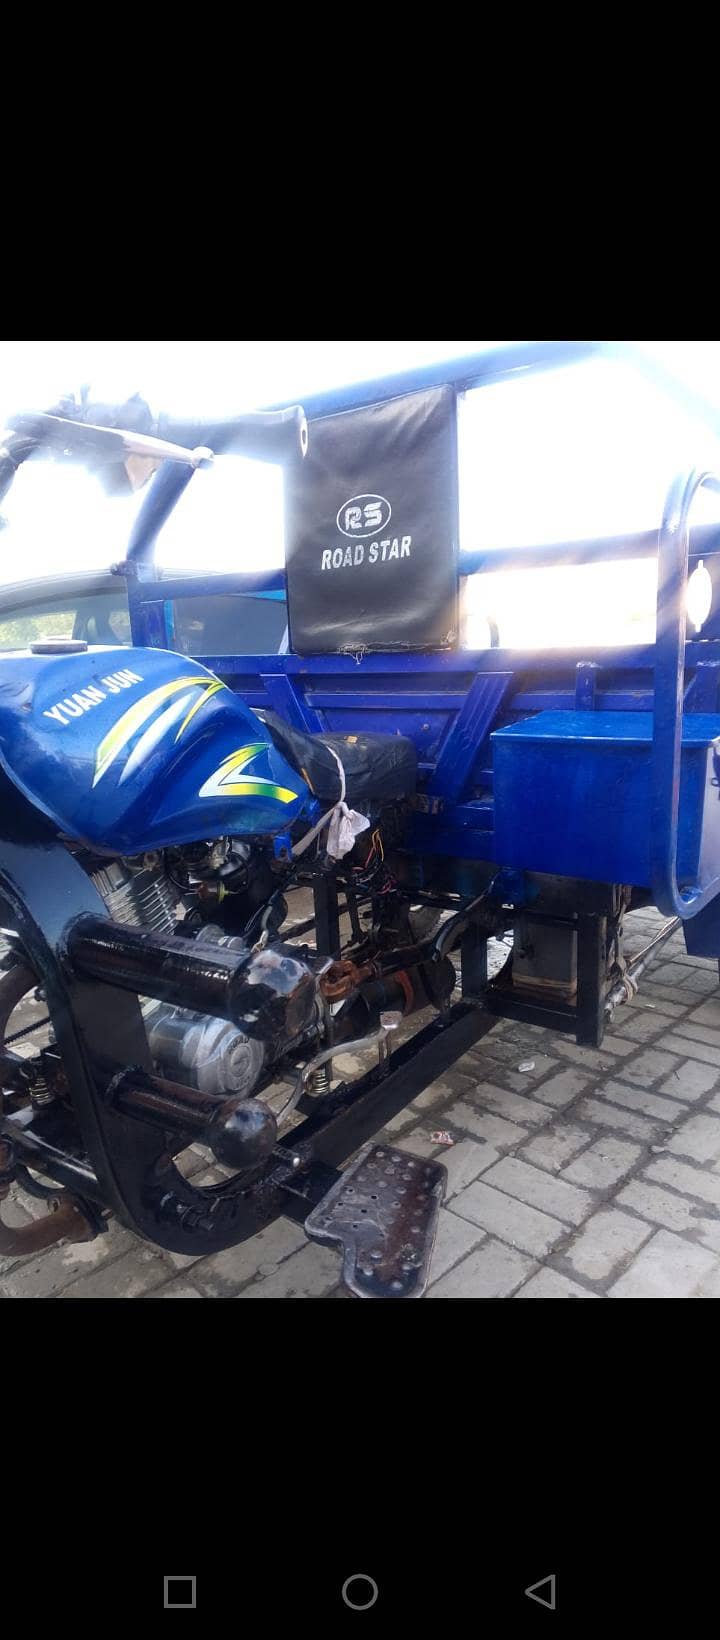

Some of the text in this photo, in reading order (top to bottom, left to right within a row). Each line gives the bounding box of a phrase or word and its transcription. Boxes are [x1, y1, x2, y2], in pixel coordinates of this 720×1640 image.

[344, 501, 383, 530] RS
[321, 535, 412, 570] ROAD STAR
[42, 668, 144, 725] YUAN JUN
